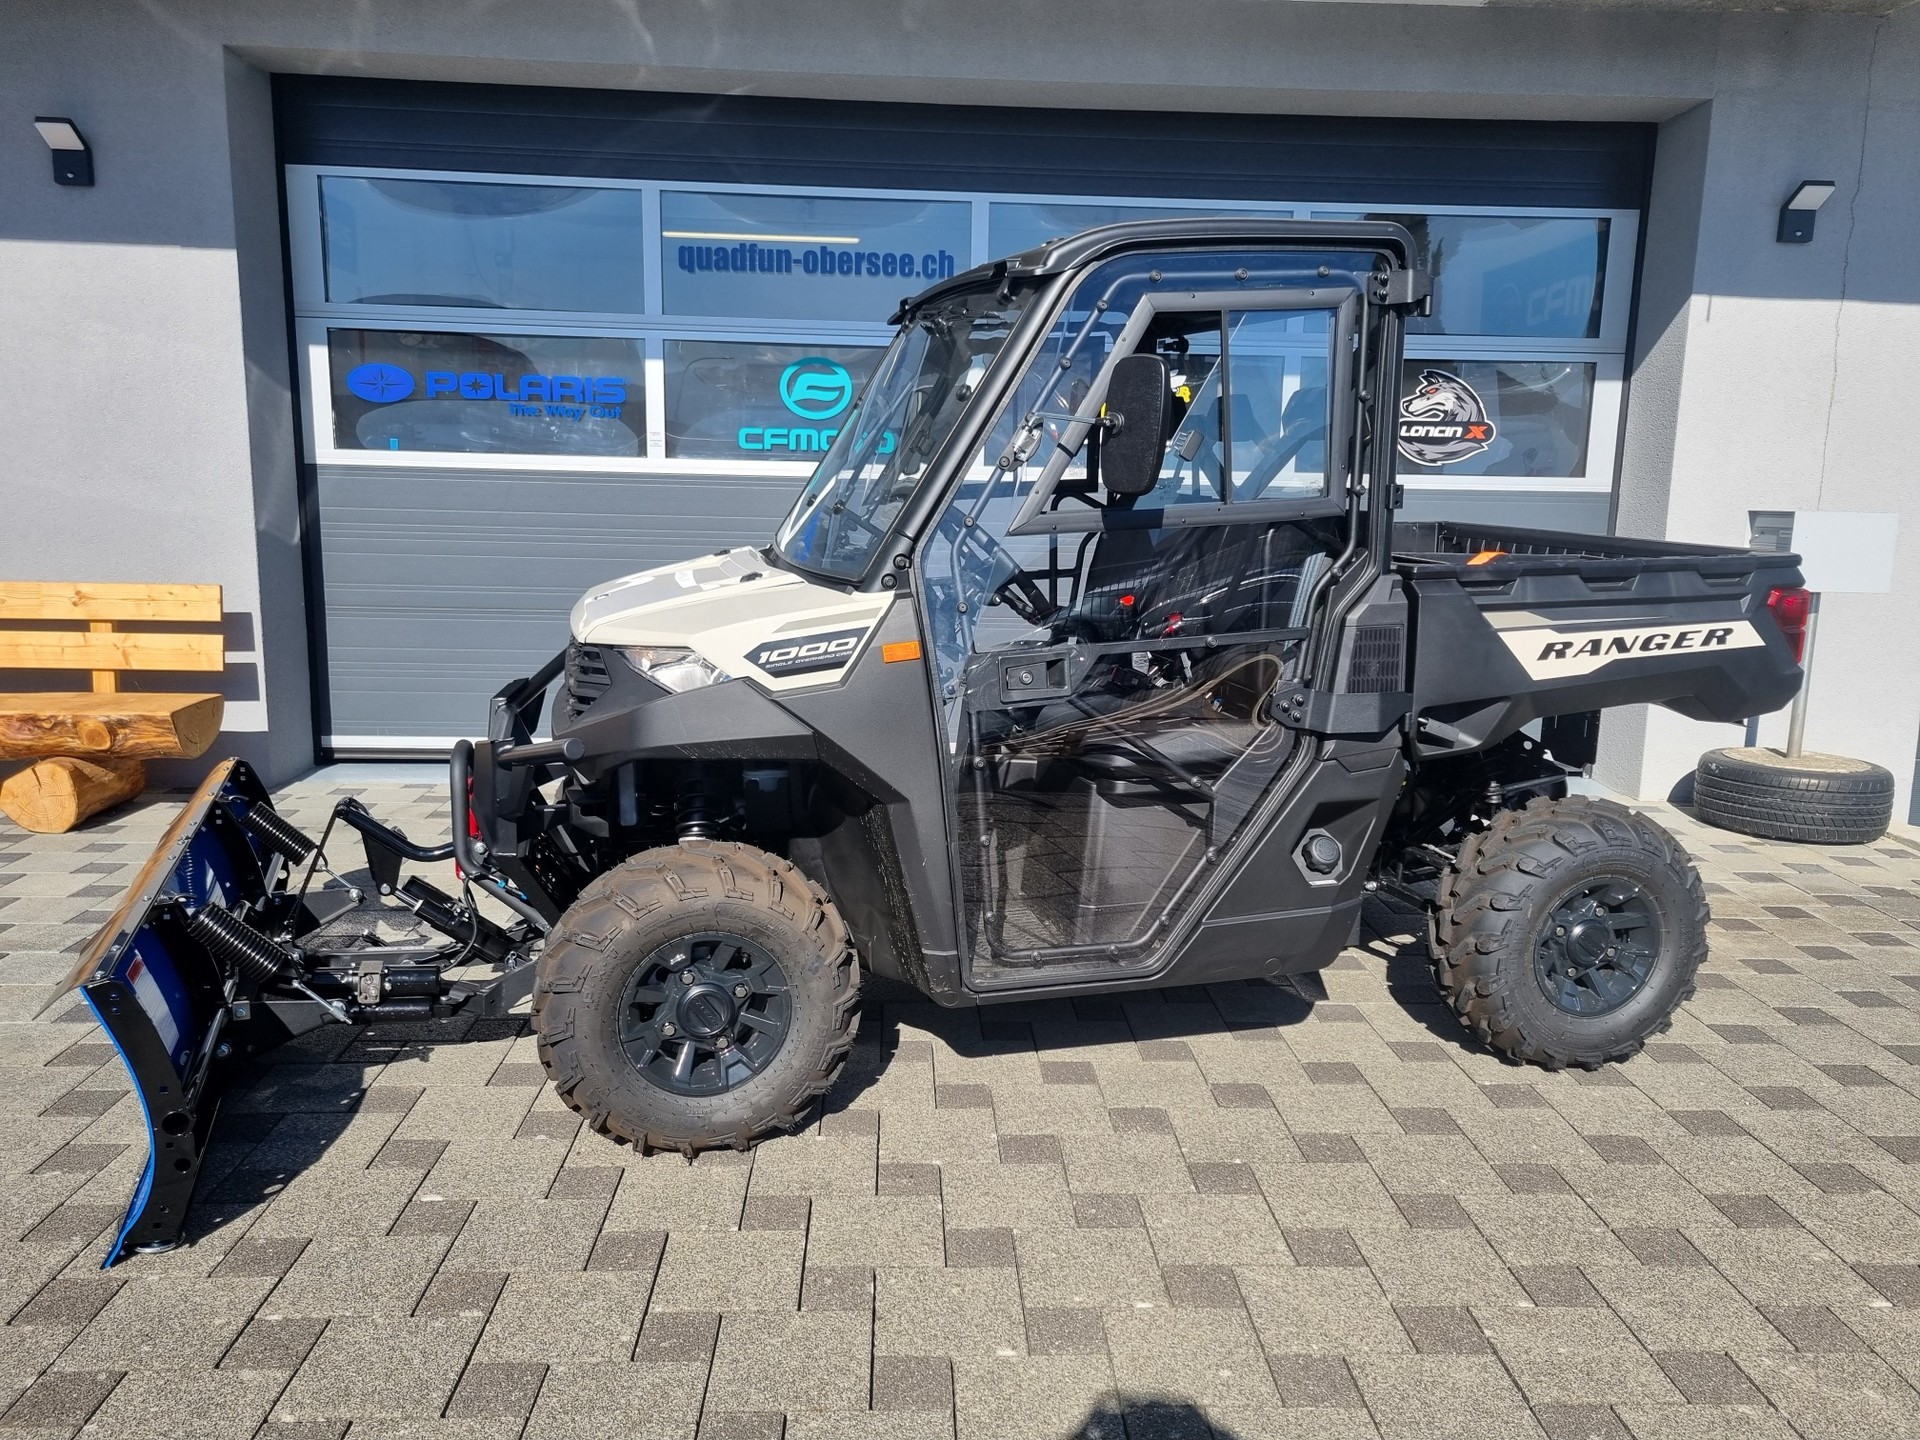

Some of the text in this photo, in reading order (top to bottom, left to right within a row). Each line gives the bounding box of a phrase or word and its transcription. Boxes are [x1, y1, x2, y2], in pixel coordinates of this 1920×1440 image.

[678, 243, 955, 278] quadfun-obersee.ch
[425, 371, 627, 404] POLARIS
[509, 403, 622, 421] The Way Out
[1399, 425, 1489, 439] LONCIN X
[758, 637, 858, 665] 1000
[1536, 627, 1734, 661] RANGER
[765, 660, 794, 669] SINGLE
[795, 653, 835, 665] OVERHEAD
